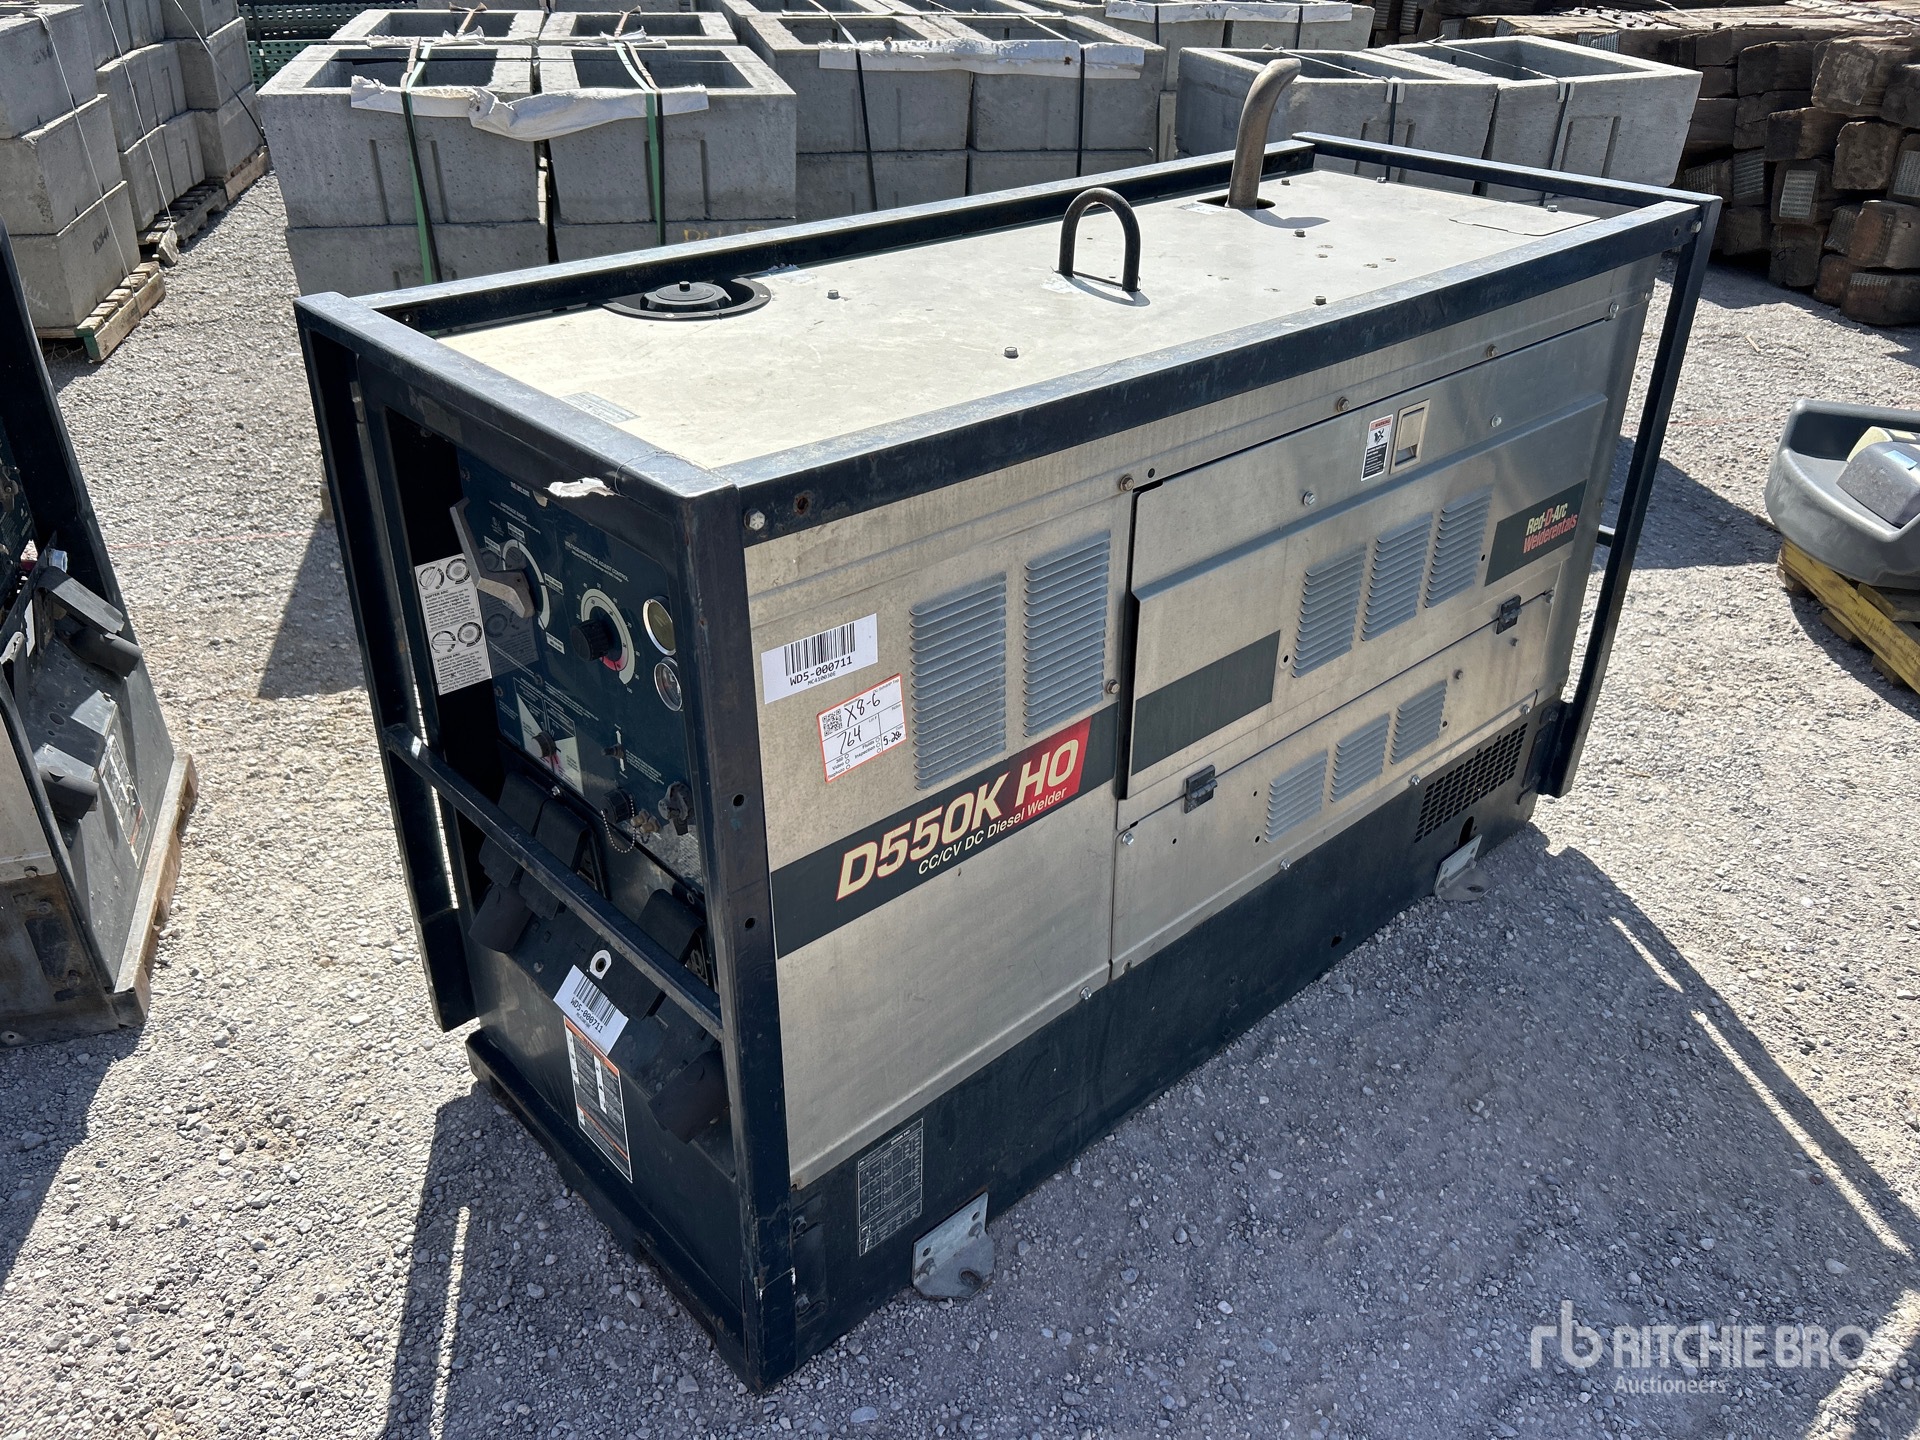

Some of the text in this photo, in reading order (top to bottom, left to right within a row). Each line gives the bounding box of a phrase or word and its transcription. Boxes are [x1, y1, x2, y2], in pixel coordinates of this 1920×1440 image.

[1523, 513, 1578, 554] Welderentals
[790, 656, 852, 686] WD5-000711
[844, 694, 880, 727] X8-6
[837, 725, 862, 754] 764
[854, 746, 876, 759] Inspection
[832, 762, 844, 770] Video
[836, 739, 1079, 902] D550K HO
[918, 788, 1066, 875] CC/CV DC Diesel Welder
[570, 997, 604, 1033] WD5-000711
